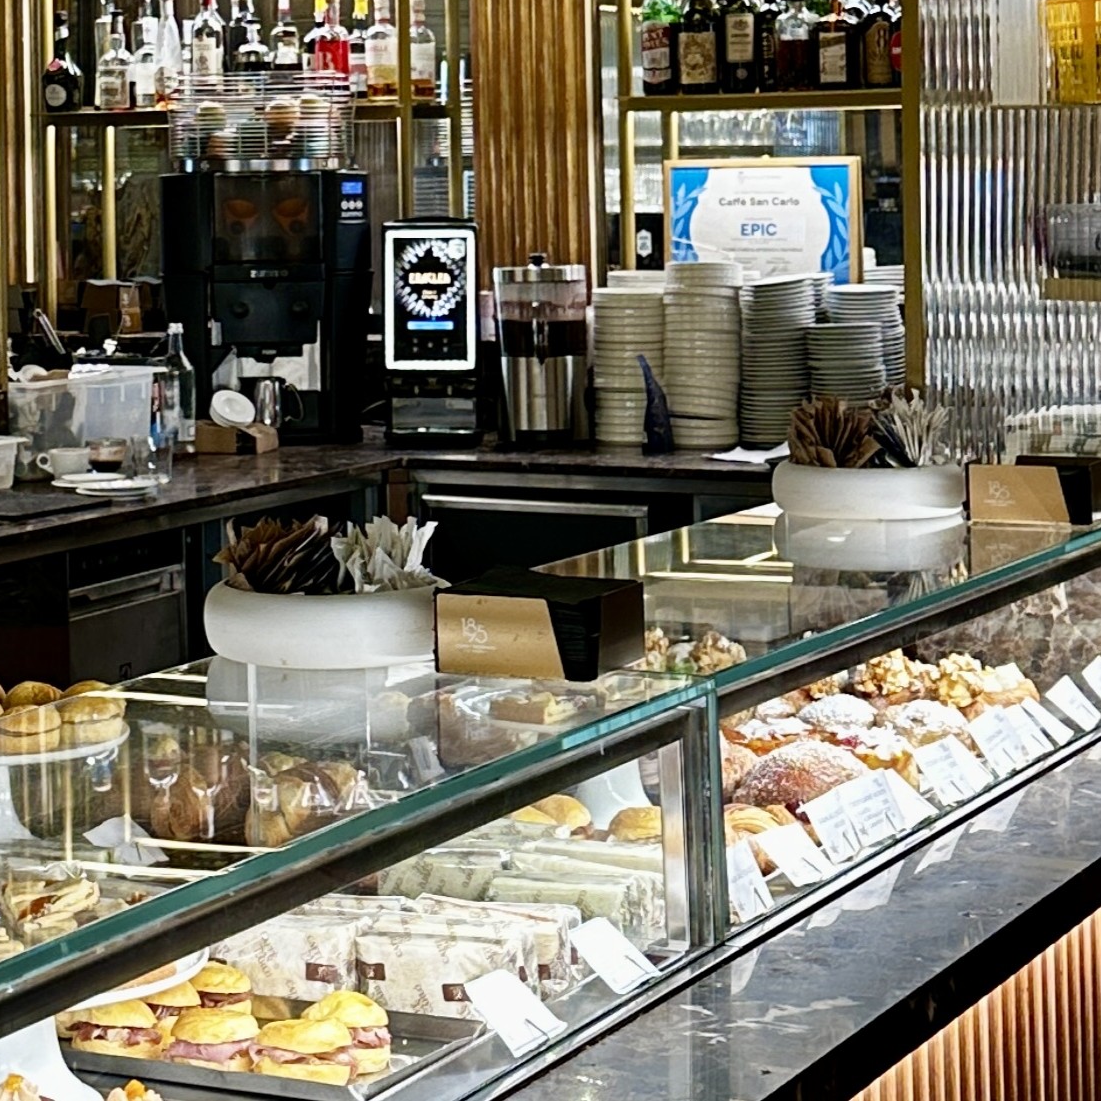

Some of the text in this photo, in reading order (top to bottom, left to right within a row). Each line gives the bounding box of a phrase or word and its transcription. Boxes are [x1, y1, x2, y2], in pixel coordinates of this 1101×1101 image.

[749, 196, 770, 206] San
[771, 196, 801, 206] Carlo
[740, 223, 778, 237] EPIC
